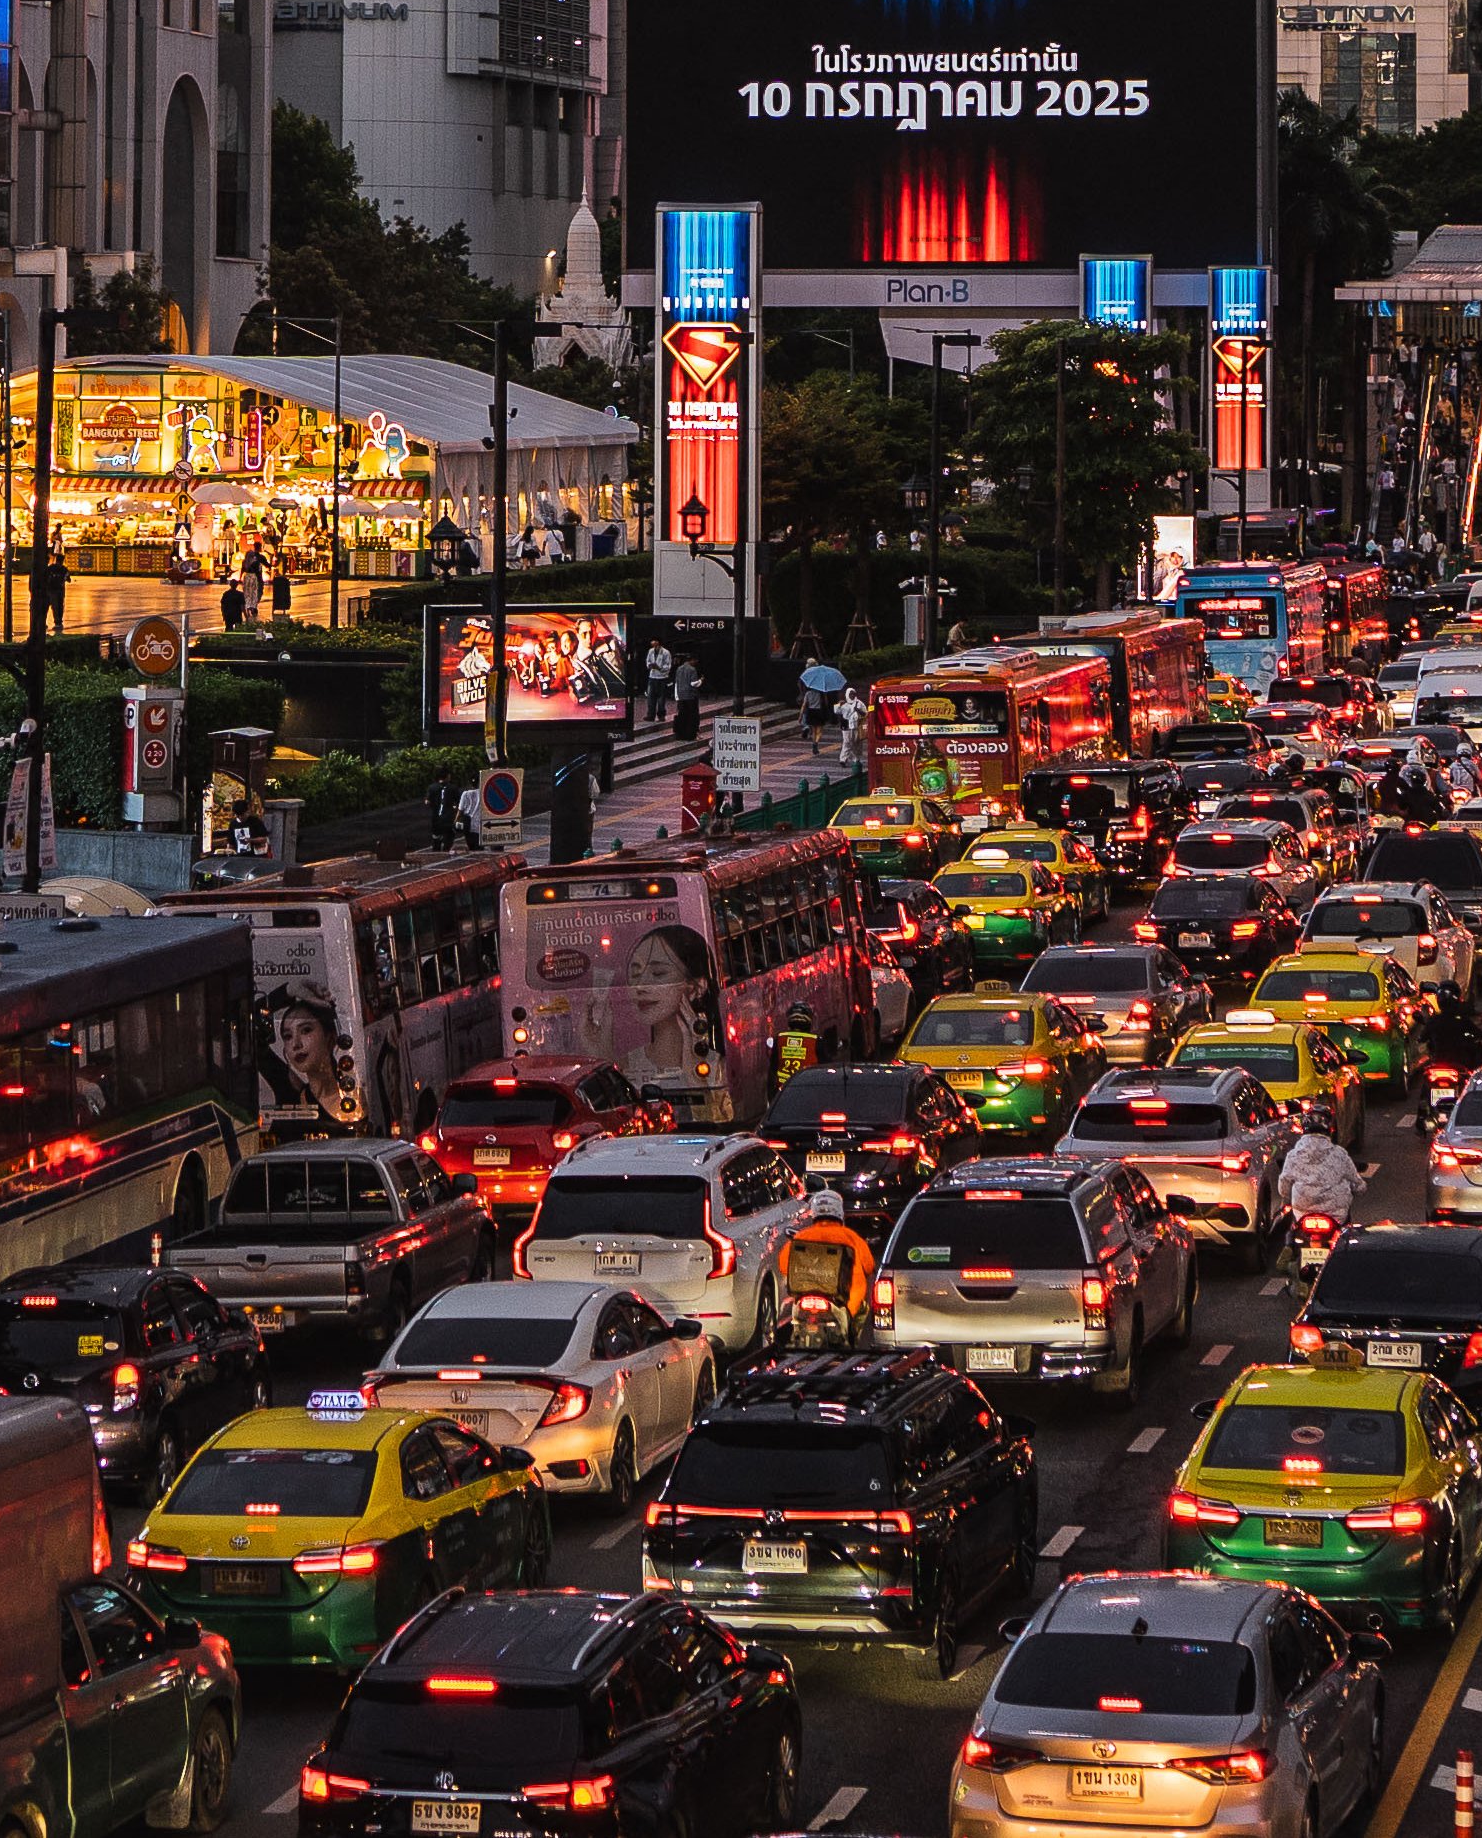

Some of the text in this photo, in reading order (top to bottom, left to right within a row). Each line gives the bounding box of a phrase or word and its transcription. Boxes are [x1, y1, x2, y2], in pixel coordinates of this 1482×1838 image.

[811, 42, 1078, 74] ในโรงภาพยนตร์เท่านั้น
[738, 80, 1149, 131] 10 กรกฎาคม 2025
[82, 427, 159, 440] BANGKOK STREET
[690, 620, 725, 630] zone B
[456, 676, 486, 692] SILVE
[718, 720, 757, 735] รถโดยสาร
[718, 739, 757, 752] ประจำทาง
[946, 739, 1009, 756] ต้องลอง
[592, 883, 610, 897] 74
[645, 910, 676, 923] odbo
[286, 943, 316, 958] odbo
[321, 1392, 348, 1408] TAXI
[774, 1545, 804, 1562] 1060
[1107, 1770, 1139, 1789] 1308
[445, 1803, 480, 1821] 3932
